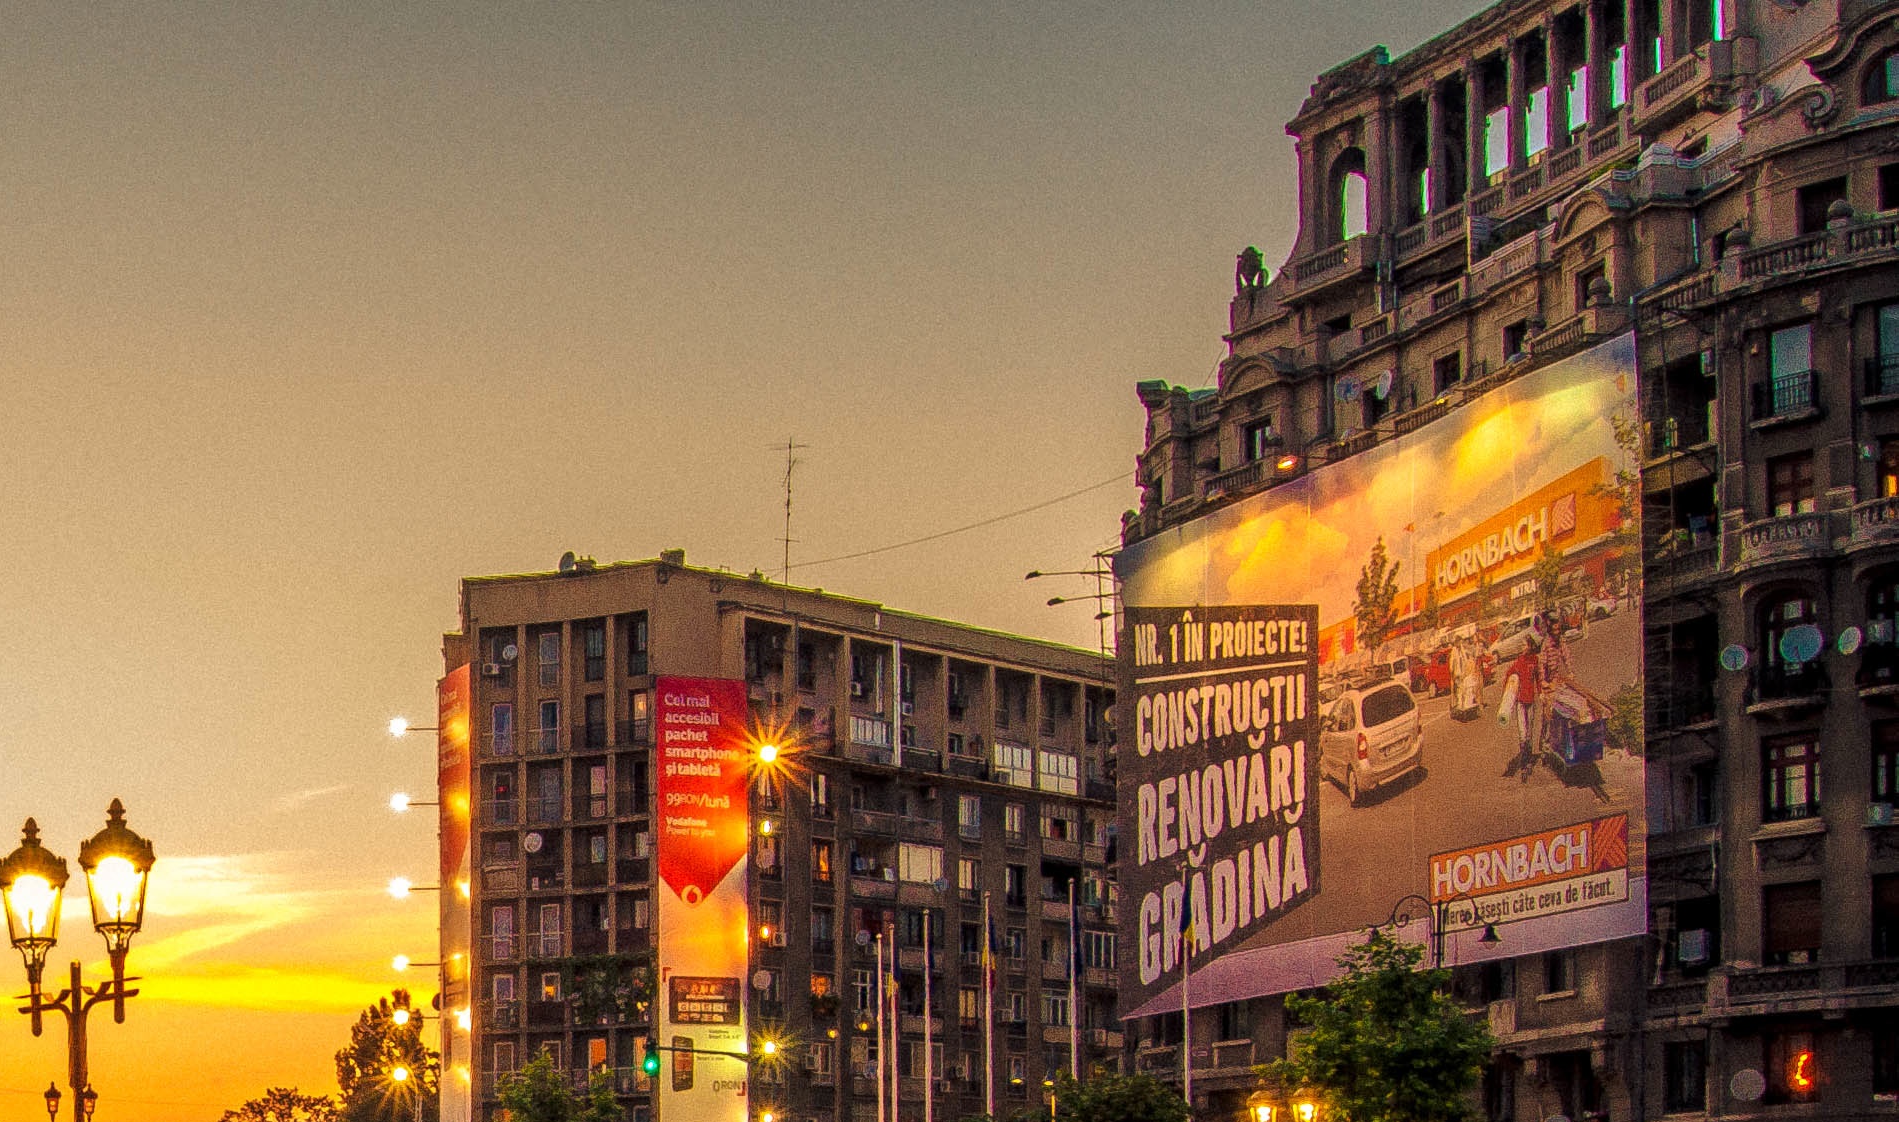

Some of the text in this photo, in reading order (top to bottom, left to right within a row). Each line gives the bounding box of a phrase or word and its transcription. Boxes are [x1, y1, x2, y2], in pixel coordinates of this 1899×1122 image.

[1435, 506, 1548, 590] HORNBACH
[1135, 609, 1308, 666] NR. 1 ÎN PROIECTE!
[664, 712, 719, 726] accesibil
[665, 728, 708, 743] pachet
[665, 746, 740, 761] smartphone
[1138, 729, 1306, 866] RENOVĂRI
[1433, 829, 1589, 897] HORNBACH
[1139, 801, 1308, 985] GRĂDINĂ
[1512, 892, 1535, 914] câte
[1538, 890, 1562, 909] ceva
[1565, 883, 1579, 904] de
